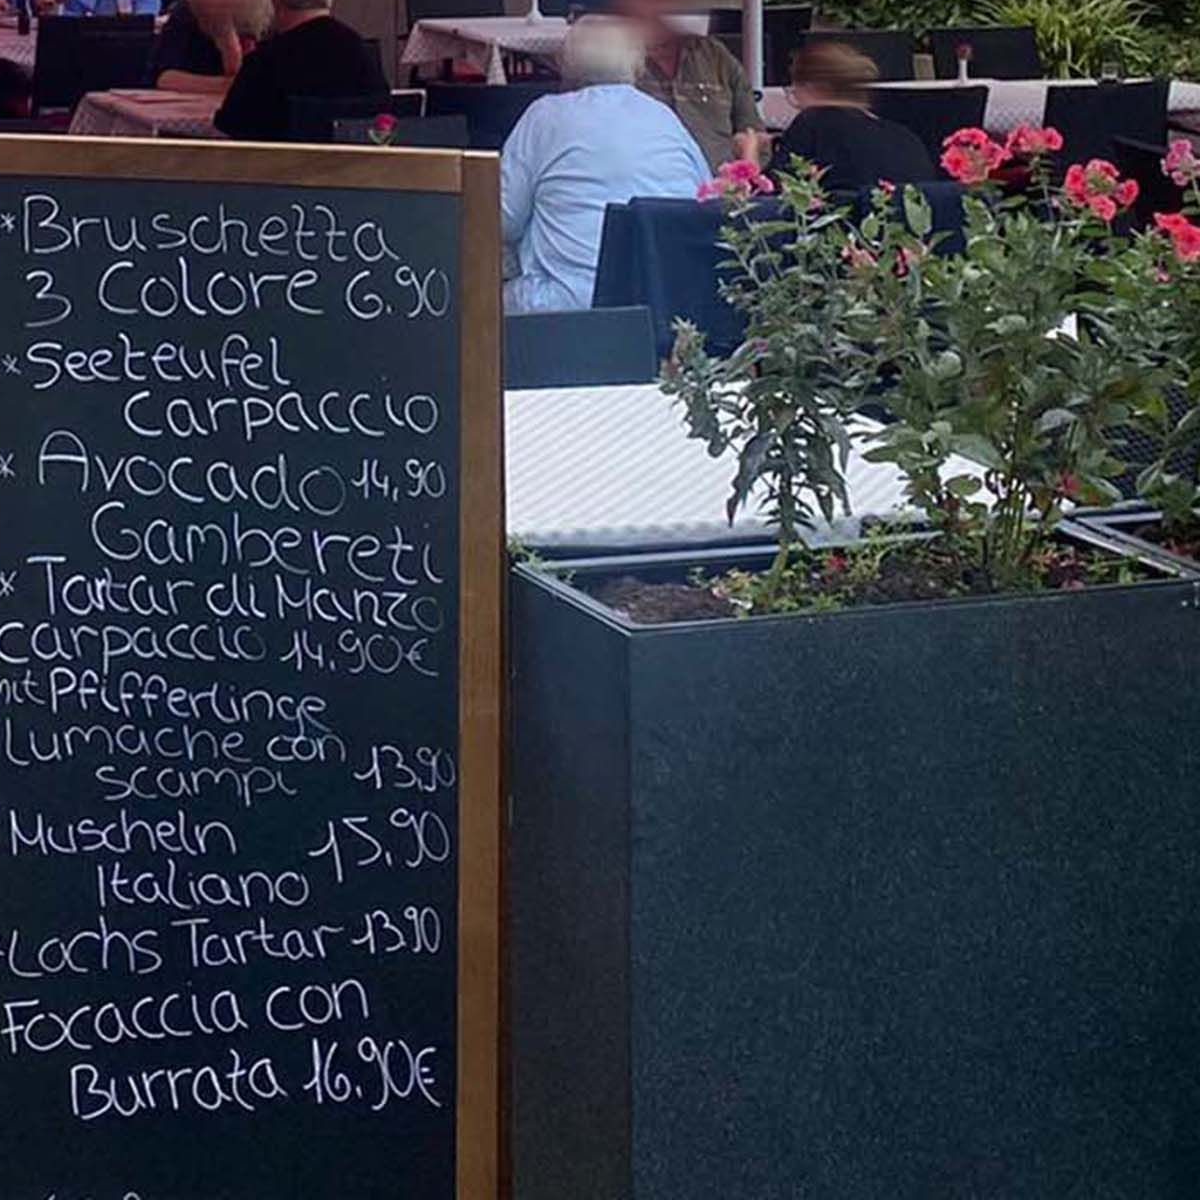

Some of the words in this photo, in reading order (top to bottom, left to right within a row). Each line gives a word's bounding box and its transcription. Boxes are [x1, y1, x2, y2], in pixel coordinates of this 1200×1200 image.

[22, 194, 401, 262] Bruschetta
[24, 270, 73, 327] 3
[97, 256, 325, 318] Colore
[37, 429, 346, 517] Avocado
[26, 554, 195, 617] Tartar
[205, 578, 268, 620] di
[277, 574, 445, 633] Manzo
[265, 732, 347, 764] con
[9, 806, 238, 856] Muscheln
[97, 858, 311, 910] Italiano
[170, 916, 346, 969] Tartar
[1, 986, 249, 1054] Focaccia
[265, 978, 369, 1031] con
[69, 1048, 289, 1121] Burrata
